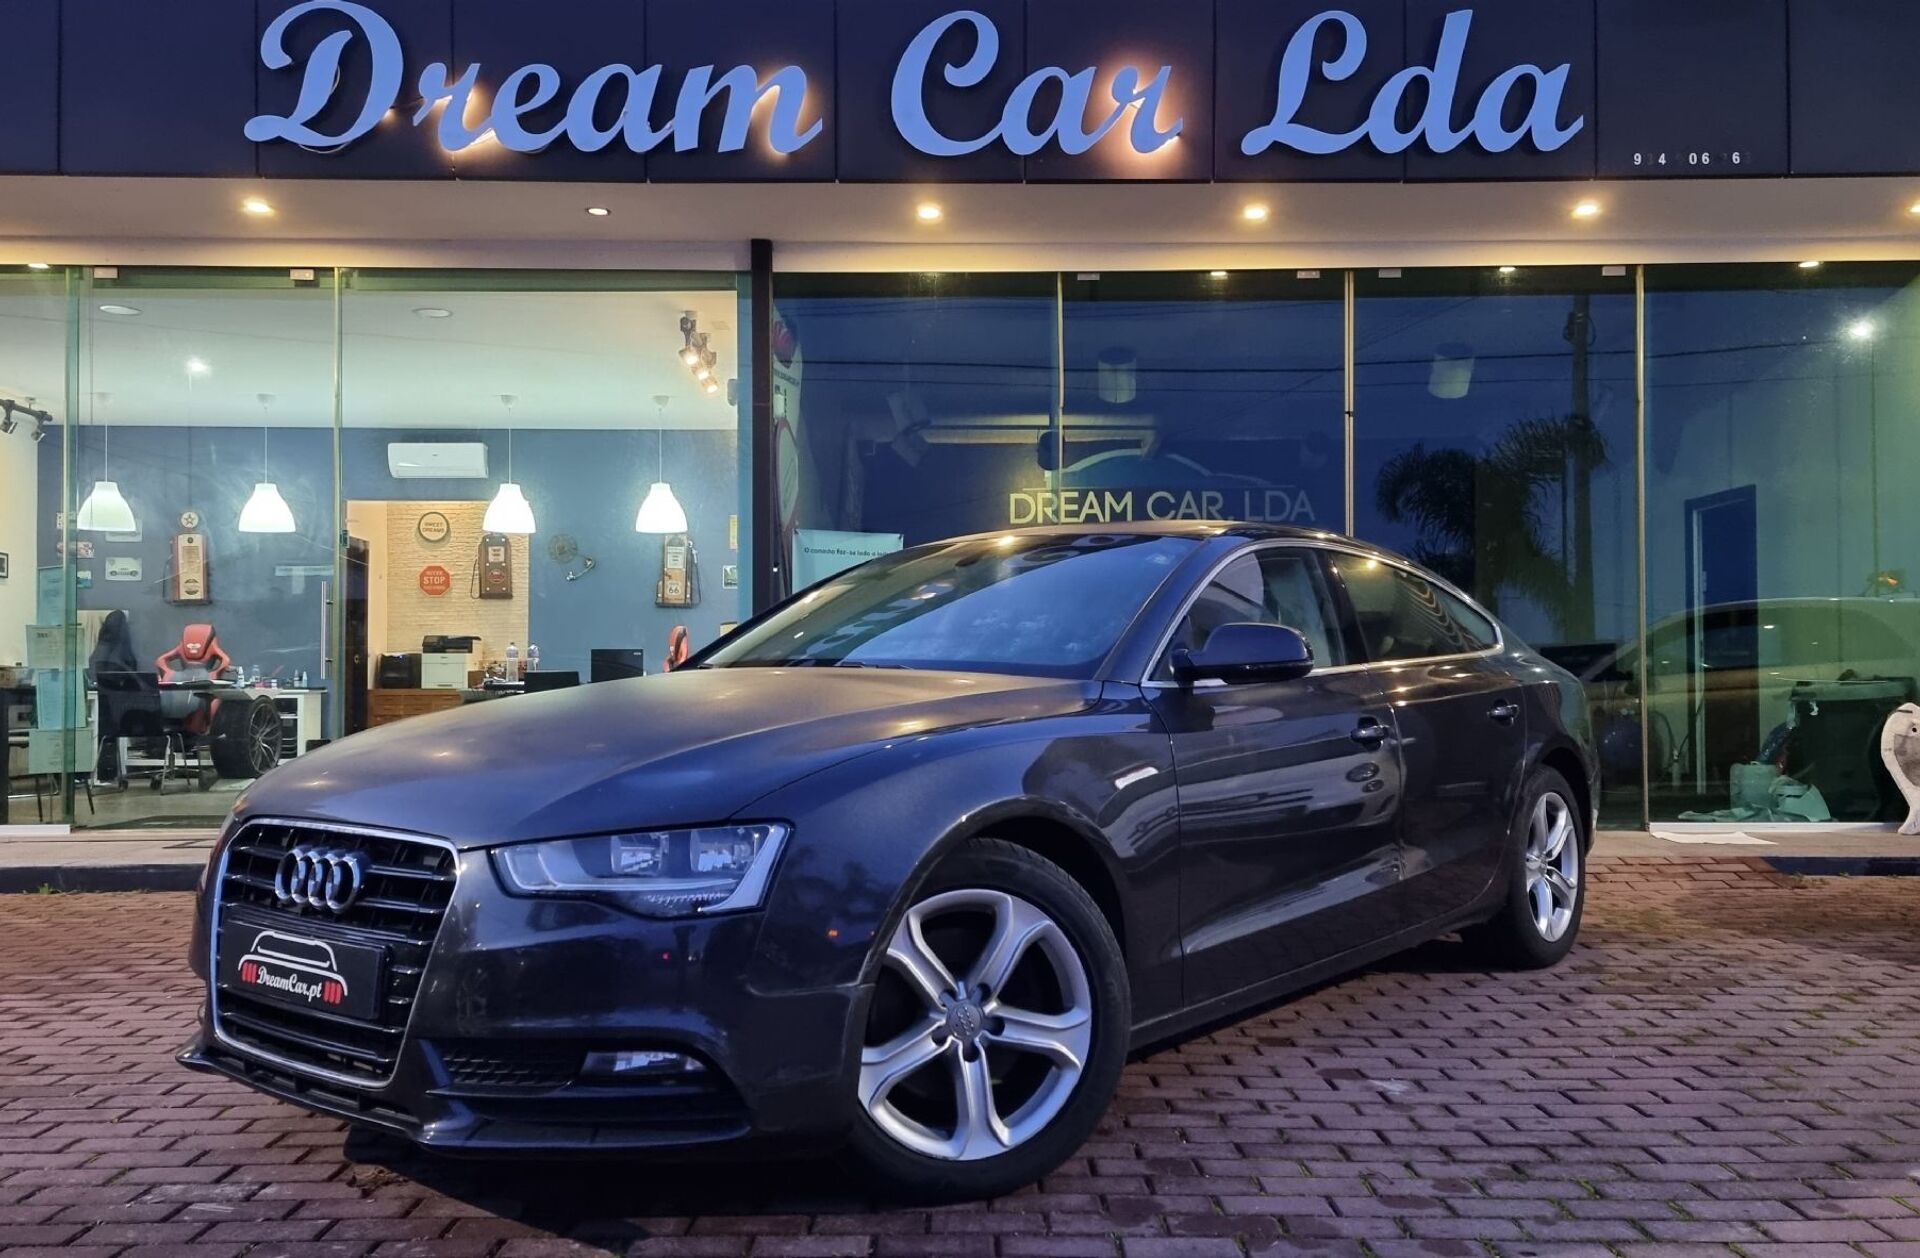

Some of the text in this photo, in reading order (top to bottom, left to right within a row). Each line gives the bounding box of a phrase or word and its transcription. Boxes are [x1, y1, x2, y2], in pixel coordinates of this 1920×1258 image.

[243, 0, 1584, 156] Dream Car Lda
[1009, 490, 1132, 524] DREAM
[1243, 490, 1316, 522] LDA
[423, 576, 446, 585] STOP
[256, 965, 323, 1003] DreamCar.pt
